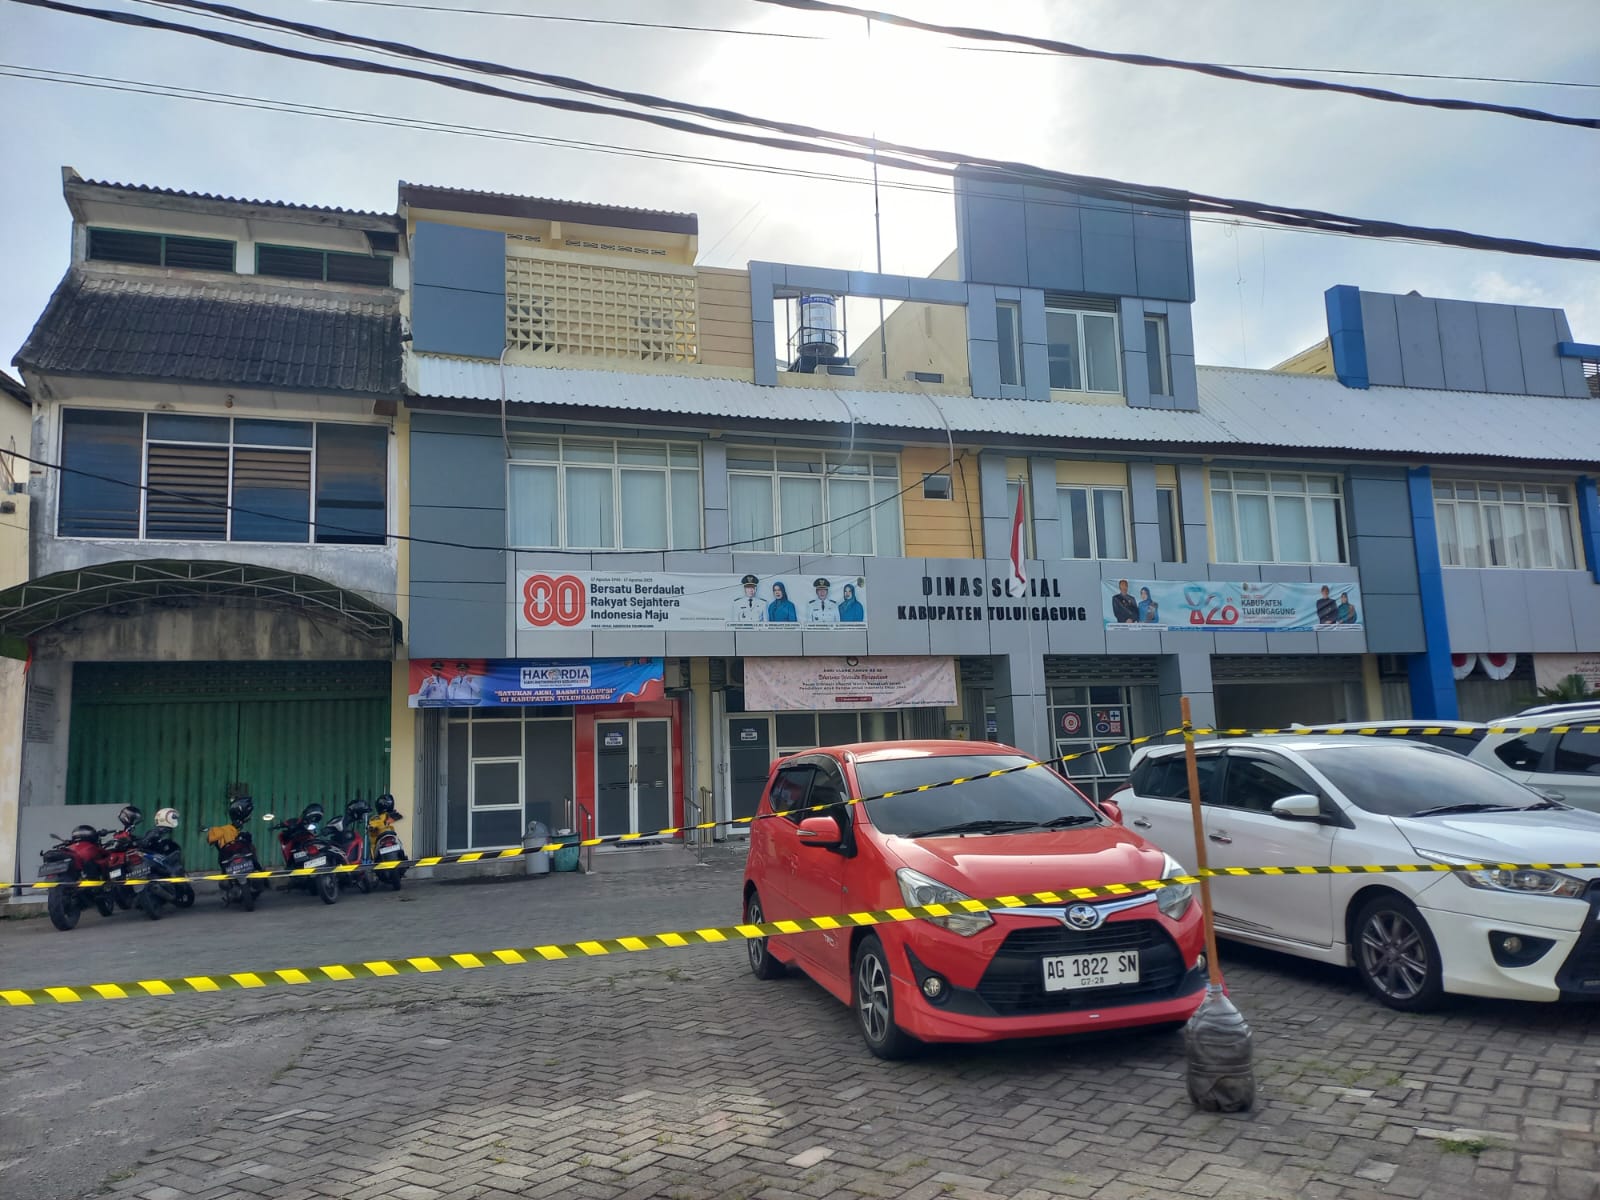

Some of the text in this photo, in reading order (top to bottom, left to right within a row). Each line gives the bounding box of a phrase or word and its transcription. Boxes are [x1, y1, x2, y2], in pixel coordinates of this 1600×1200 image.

[590, 583, 685, 595] Bersatu Berdaulat
[922, 576, 983, 597] DINAS
[522, 573, 586, 627] 80
[590, 596, 680, 609] Rakyat Sejahtera
[1241, 599, 1282, 607] KABUPATEN
[590, 609, 643, 620] Indonesia
[645, 609, 669, 622] Maju
[897, 606, 982, 621] KABUPATEN
[1242, 607, 1297, 616] TULUNGAGUNG
[1047, 954, 1137, 980] AG 1822 SN
